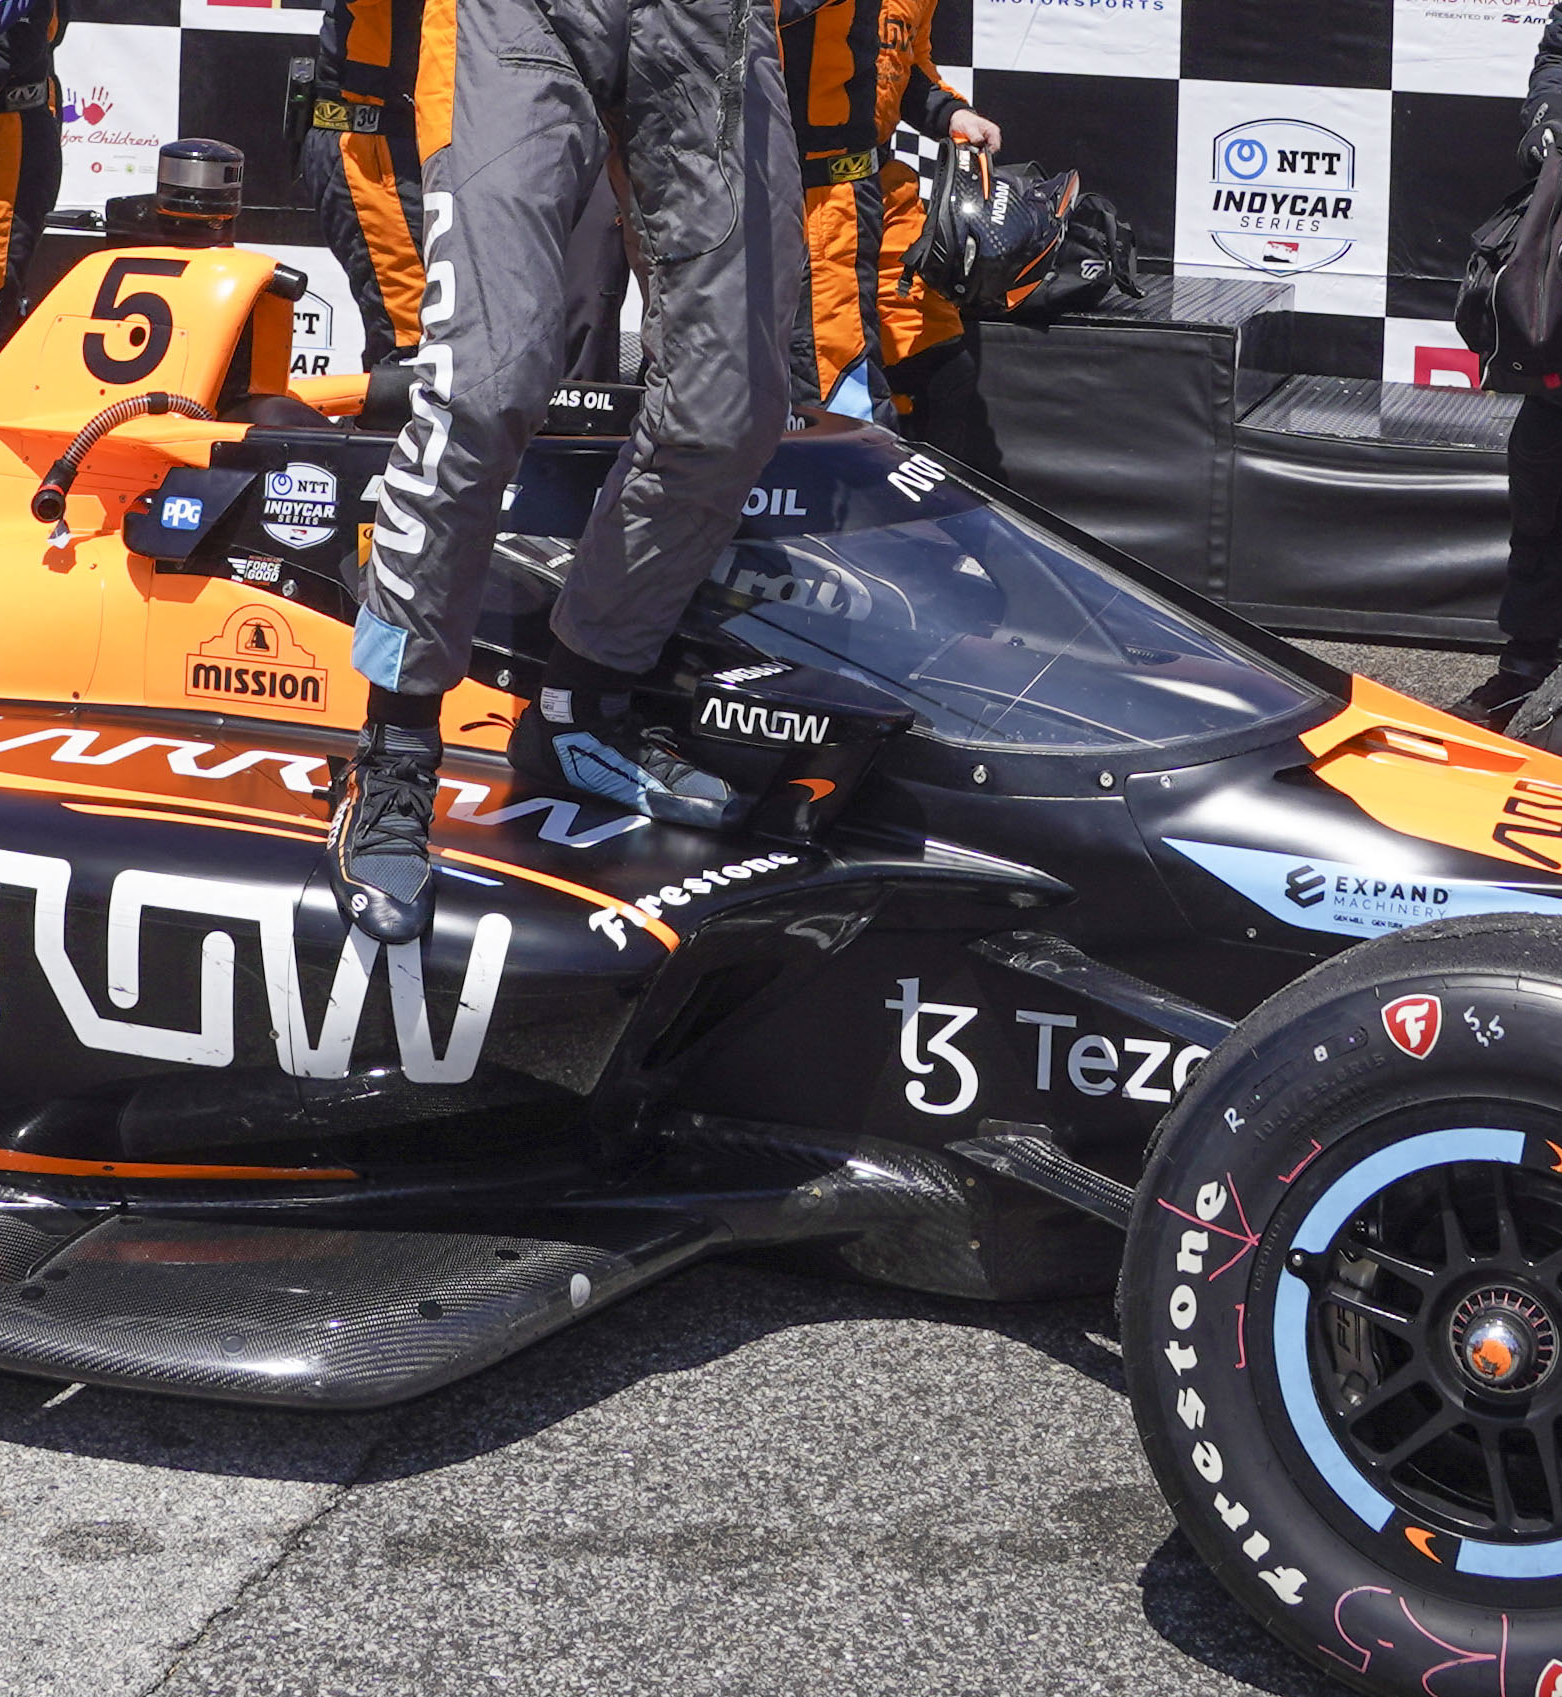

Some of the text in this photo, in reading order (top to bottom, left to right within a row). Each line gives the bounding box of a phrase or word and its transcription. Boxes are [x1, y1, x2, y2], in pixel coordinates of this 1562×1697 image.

[1425, 11, 1481, 21] PRESENTED
[355, 107, 379, 127] 30
[60, 129, 159, 147] for Children's
[1277, 150, 1341, 175] NTT
[1213, 189, 1353, 219] INDYCAR
[1241, 215, 1321, 232] SERIES
[82, 257, 190, 386] 5
[583, 391, 615, 411] OIL
[297, 479, 329, 494] NTT
[163, 499, 202, 527] PPG
[264, 500, 336, 519] INDYCAR
[740, 487, 808, 517] OIL
[277, 514, 319, 526] SERIES
[245, 569, 280, 583] GOOD
[246, 559, 282, 573] FORCE
[192, 661, 322, 705] MISSION
[699, 696, 831, 745] ARROW
[586, 848, 799, 953] Firestone
[1335, 876, 1449, 905] EXPAND
[1333, 895, 1447, 920] MACHINERY
[1162, 1180, 1308, 1607] Firestone
